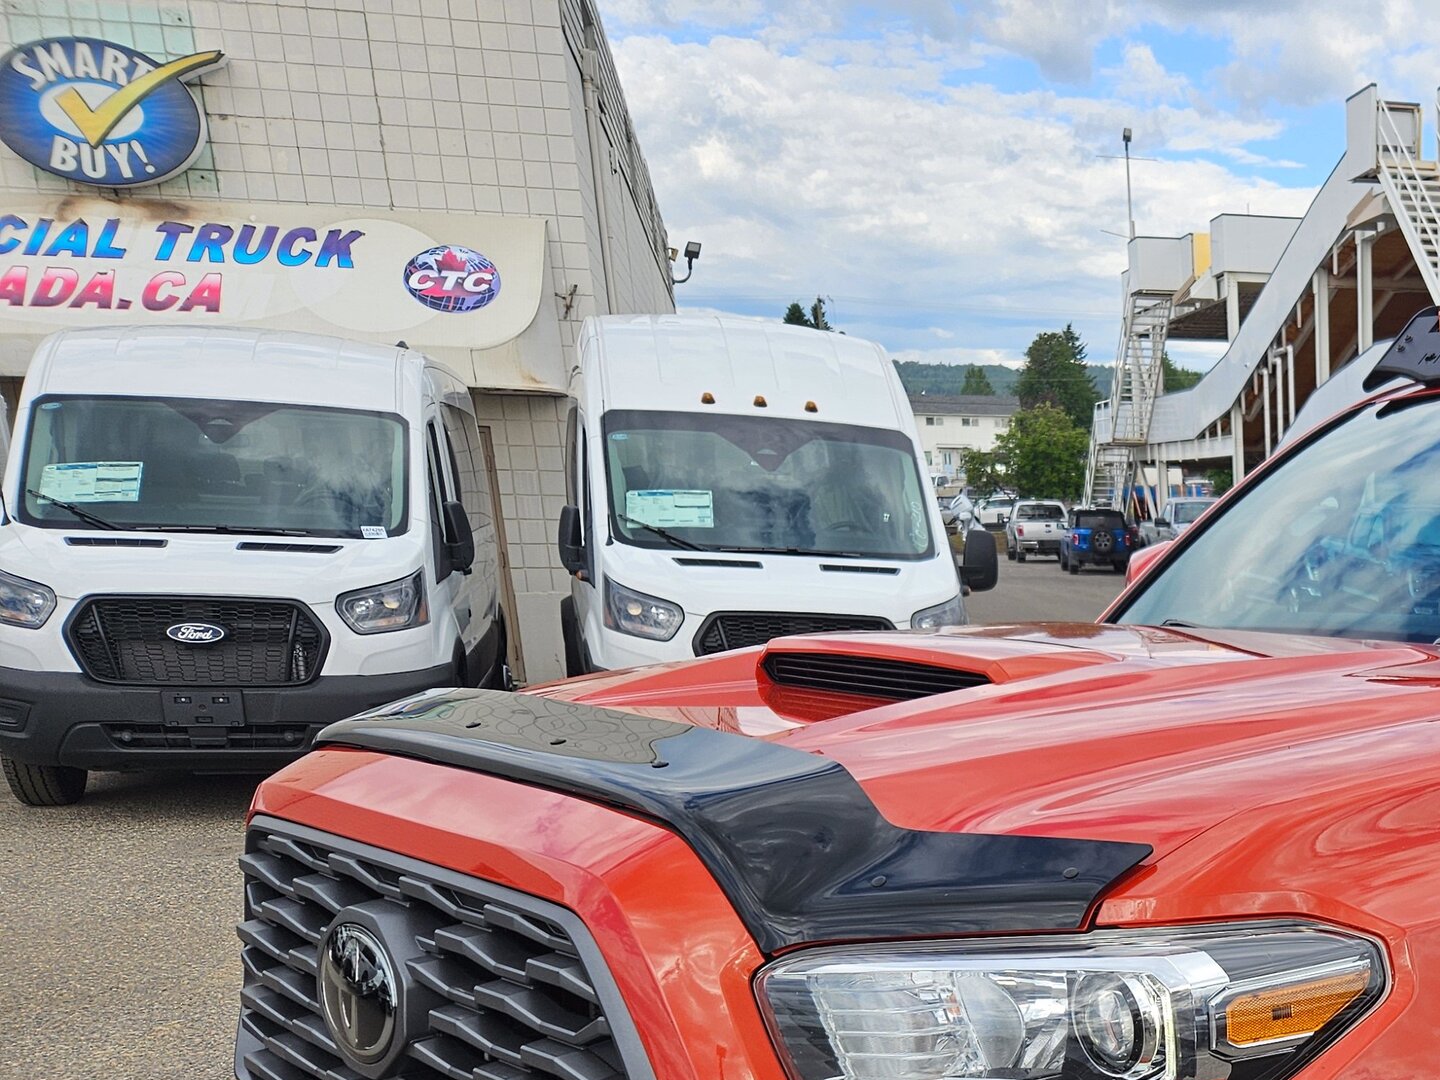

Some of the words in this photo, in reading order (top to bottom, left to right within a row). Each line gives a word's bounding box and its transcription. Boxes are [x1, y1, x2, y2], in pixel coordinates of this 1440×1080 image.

[11, 42, 154, 91] SMART
[50, 135, 155, 179] BUY!
[155, 221, 366, 269] TRUCK
[408, 268, 493, 293] CTC
[178, 625, 213, 640] Ford
